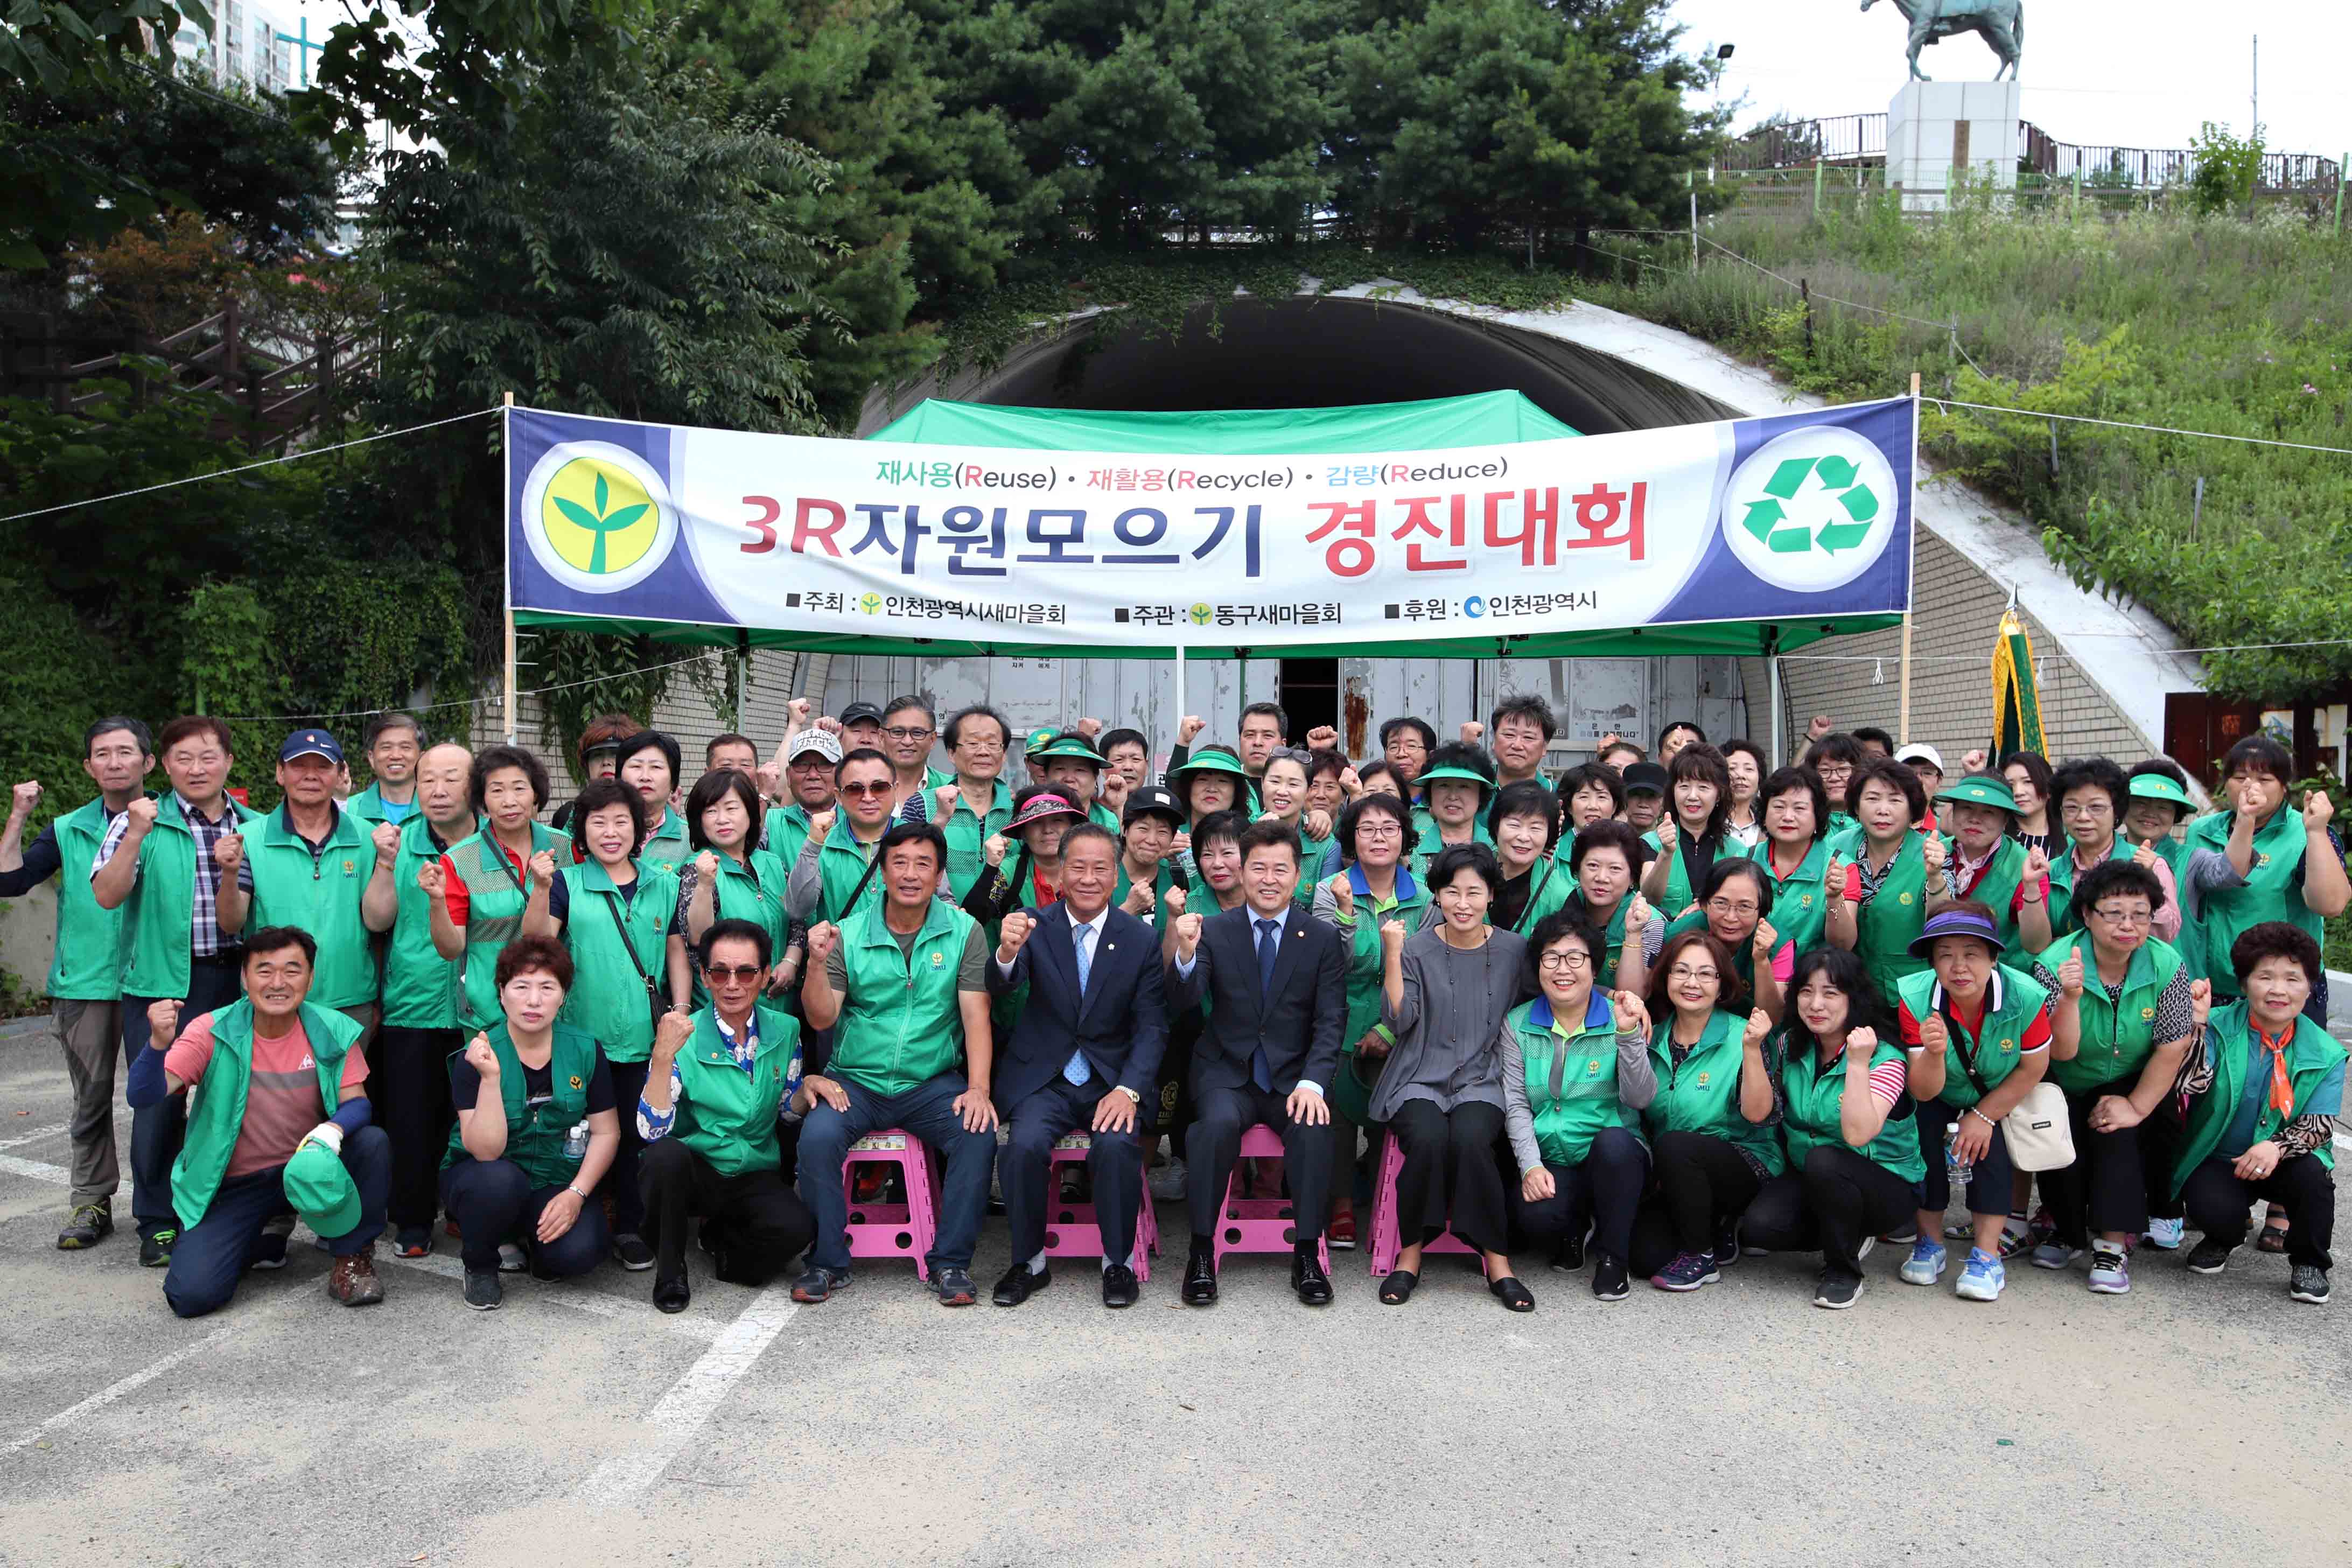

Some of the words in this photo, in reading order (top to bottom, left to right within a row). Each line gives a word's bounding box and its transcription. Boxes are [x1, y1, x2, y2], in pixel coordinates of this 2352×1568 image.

[740, 495, 1262, 577] 3R자원모으기
[1305, 481, 1647, 577] 경진대회
[885, 594, 1066, 625] 인천광역시새마을회
[1215, 603, 1342, 626] 동구새마을회
[1489, 590, 1597, 618] 인천광역시
